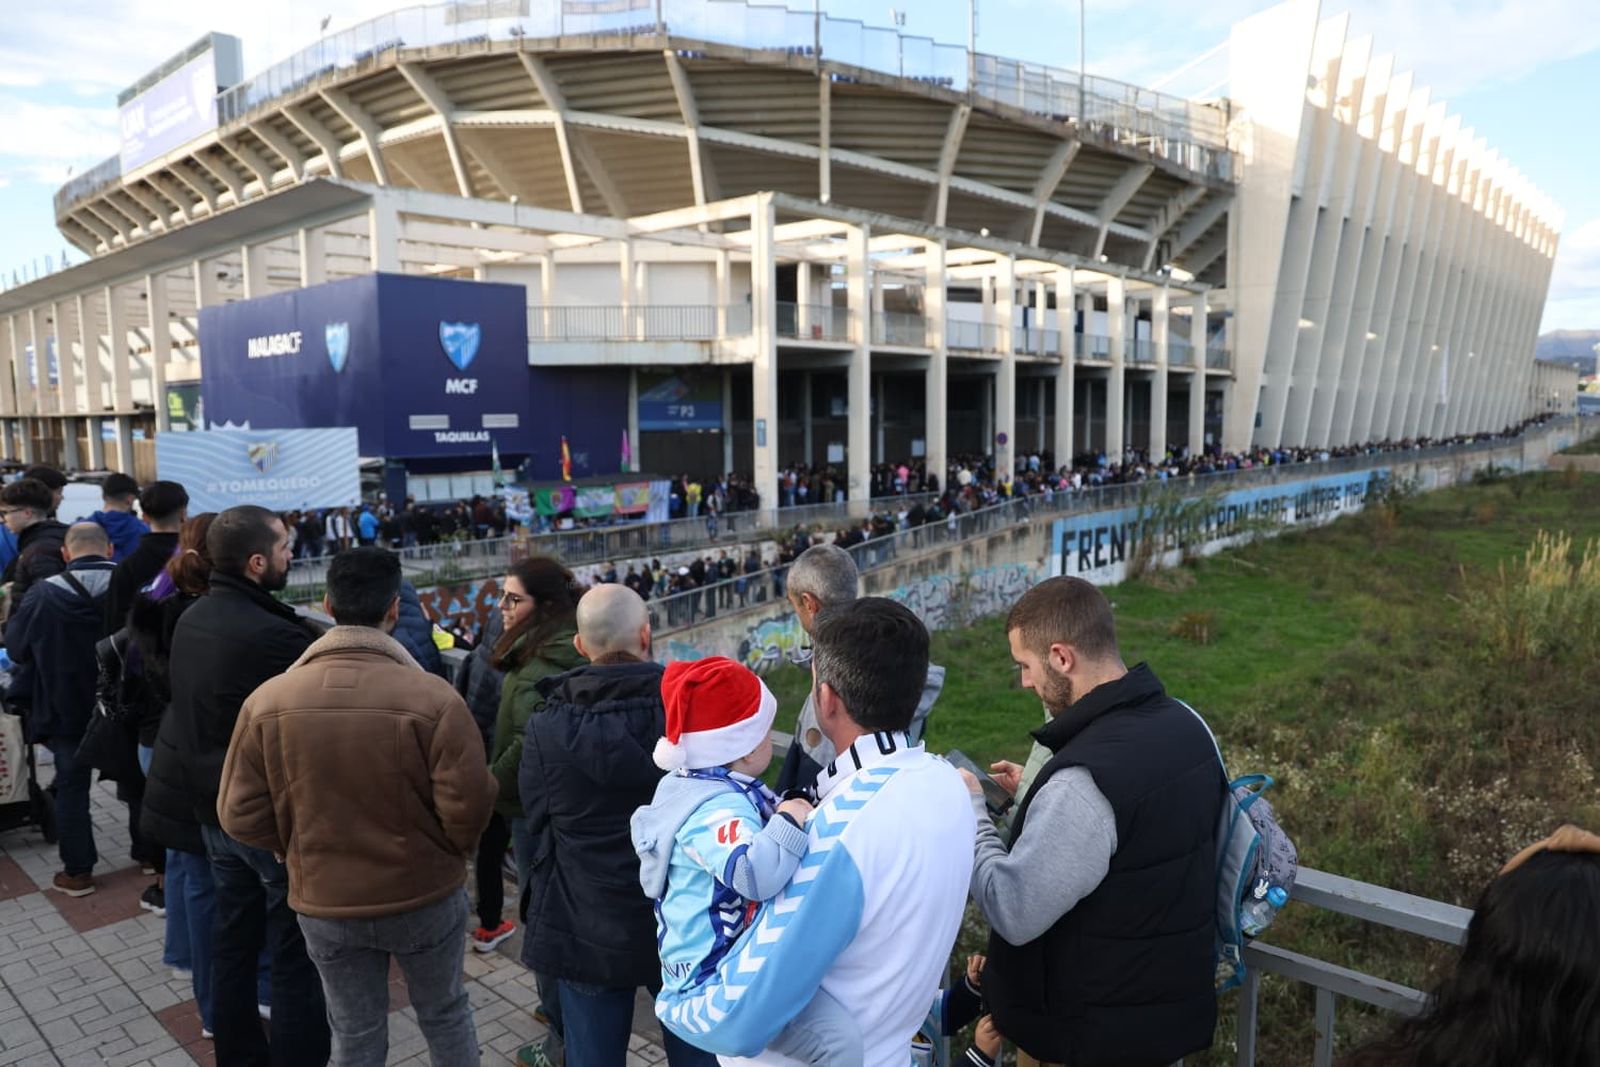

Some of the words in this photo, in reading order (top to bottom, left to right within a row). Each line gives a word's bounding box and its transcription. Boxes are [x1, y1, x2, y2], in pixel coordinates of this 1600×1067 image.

[445, 378, 478, 394] MCF
[434, 431, 490, 443] TAQUILLAS
[206, 476, 322, 493] #YOMEQUEDO
